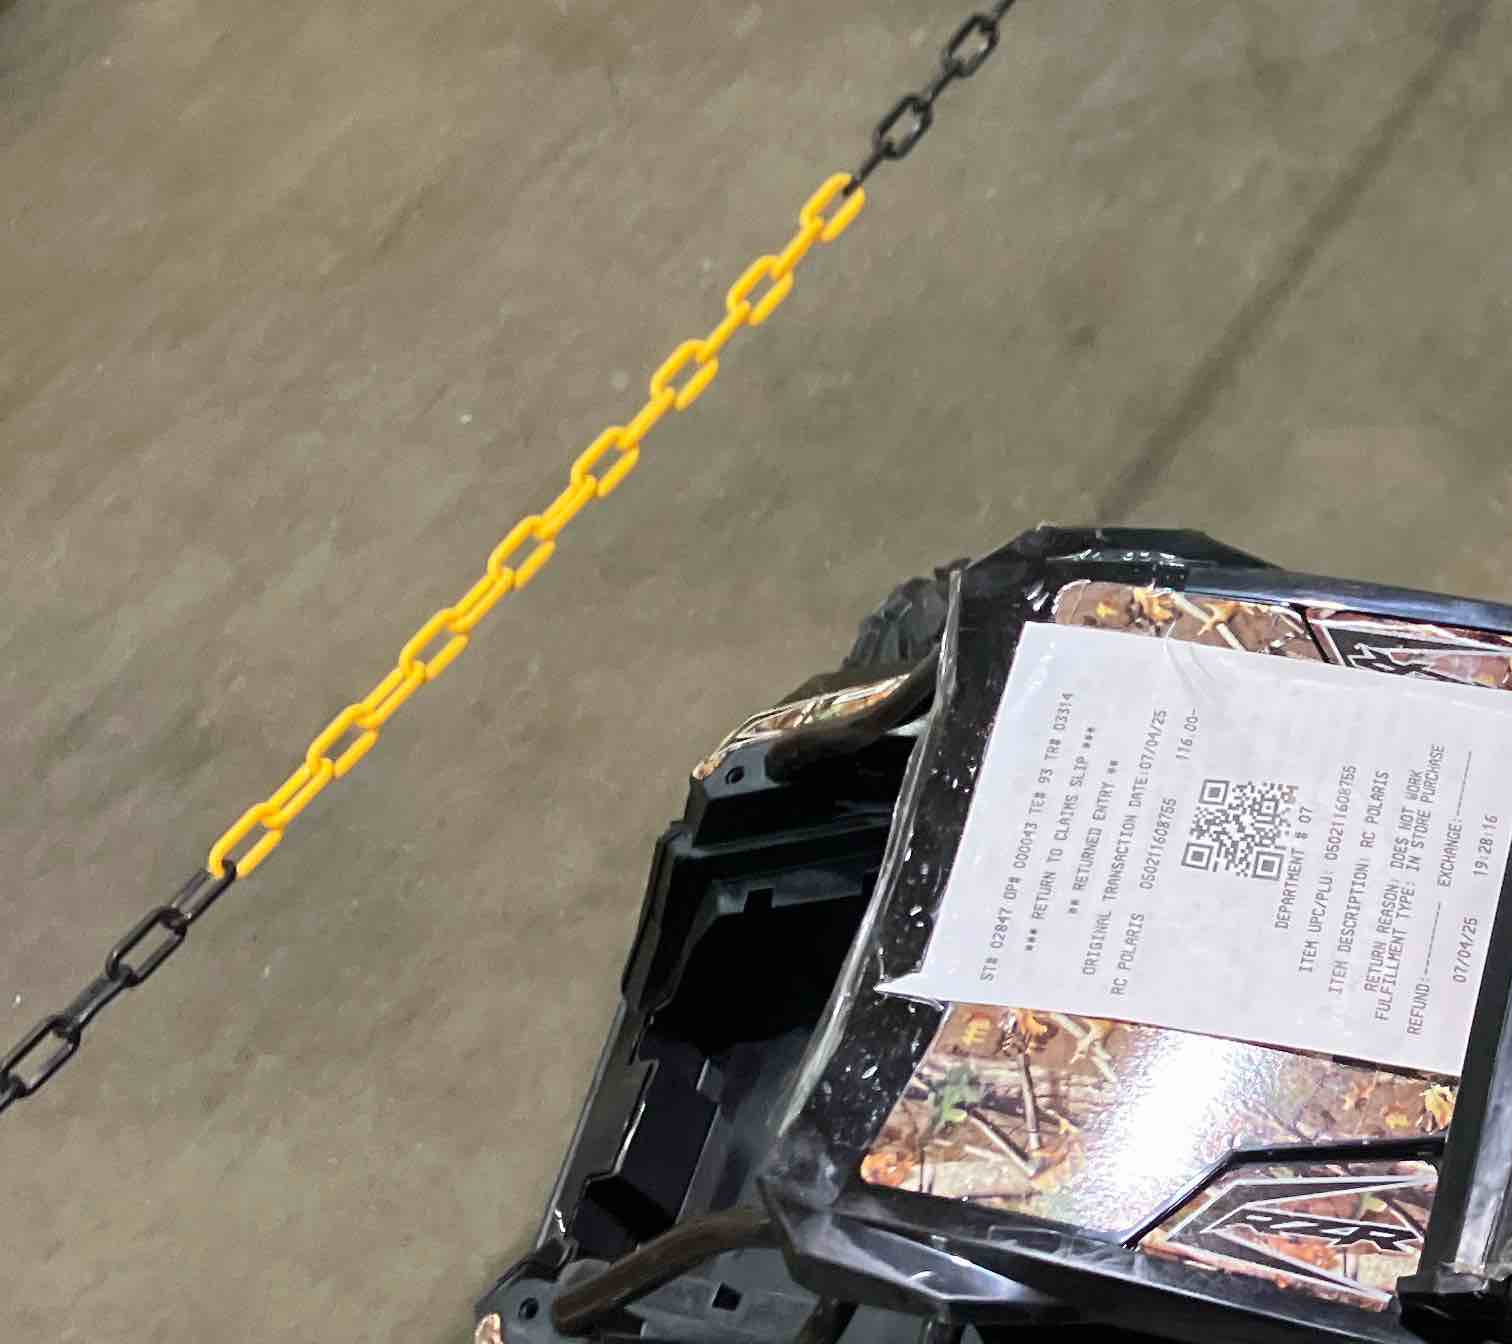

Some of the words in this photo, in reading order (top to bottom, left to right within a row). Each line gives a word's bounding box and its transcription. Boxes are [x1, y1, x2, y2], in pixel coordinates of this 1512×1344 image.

[1053, 692, 1073, 730] 03314
[1044, 738, 1062, 761] TR#
[1038, 767, 1053, 784] 93
[1070, 756, 1089, 788] SLIP
[1405, 769, 1424, 800] WORK
[1421, 744, 1445, 804] PURCHASE
[1029, 791, 1047, 817] TE#
[1298, 806, 1313, 824] 07
[1364, 769, 1389, 825] POLARIS
[1054, 794, 1079, 841] CLAIMS
[1073, 827, 1103, 891] RETURNED
[1092, 781, 1116, 821] ENTRY
[1294, 832, 1309, 840] #
[1399, 804, 1415, 832] NOT
[1411, 810, 1431, 849] STORE
[1014, 822, 1038, 869] 000043
[1048, 848, 1063, 863] TO
[1140, 797, 1177, 890] 050211608755
[1360, 831, 1376, 848] RC
[1390, 837, 1409, 869] DOES
[1298, 939, 1319, 974] ITEM
[1309, 871, 1335, 934] UPC/PLU:
[1324, 765, 1357, 861] 050211608755
[1406, 854, 1421, 872] IN
[1003, 876, 1022, 901] OP#
[1032, 871, 1056, 920] RETURN
[1082, 910, 1112, 976] ORIGINAL
[1102, 814, 1137, 903] TRANSACTION
[1275, 848, 1305, 929] DEPARTMENT
[1337, 858, 1370, 953] DESCRIPTION:
[1395, 880, 1416, 920] TYPE:
[1452, 916, 1477, 983] 07/04/25
[1472, 814, 1498, 876] 19:28:16
[990, 906, 1014, 950] 02847
[1376, 879, 1400, 940] REASON:
[1118, 913, 1144, 972] POLARIS
[980, 957, 999, 981] ST#
[1328, 960, 1348, 993] ITEM
[1364, 940, 1387, 993] RETURN
[1375, 928, 1407, 1021] FULFILLMENT
[1110, 977, 1127, 997] RC
